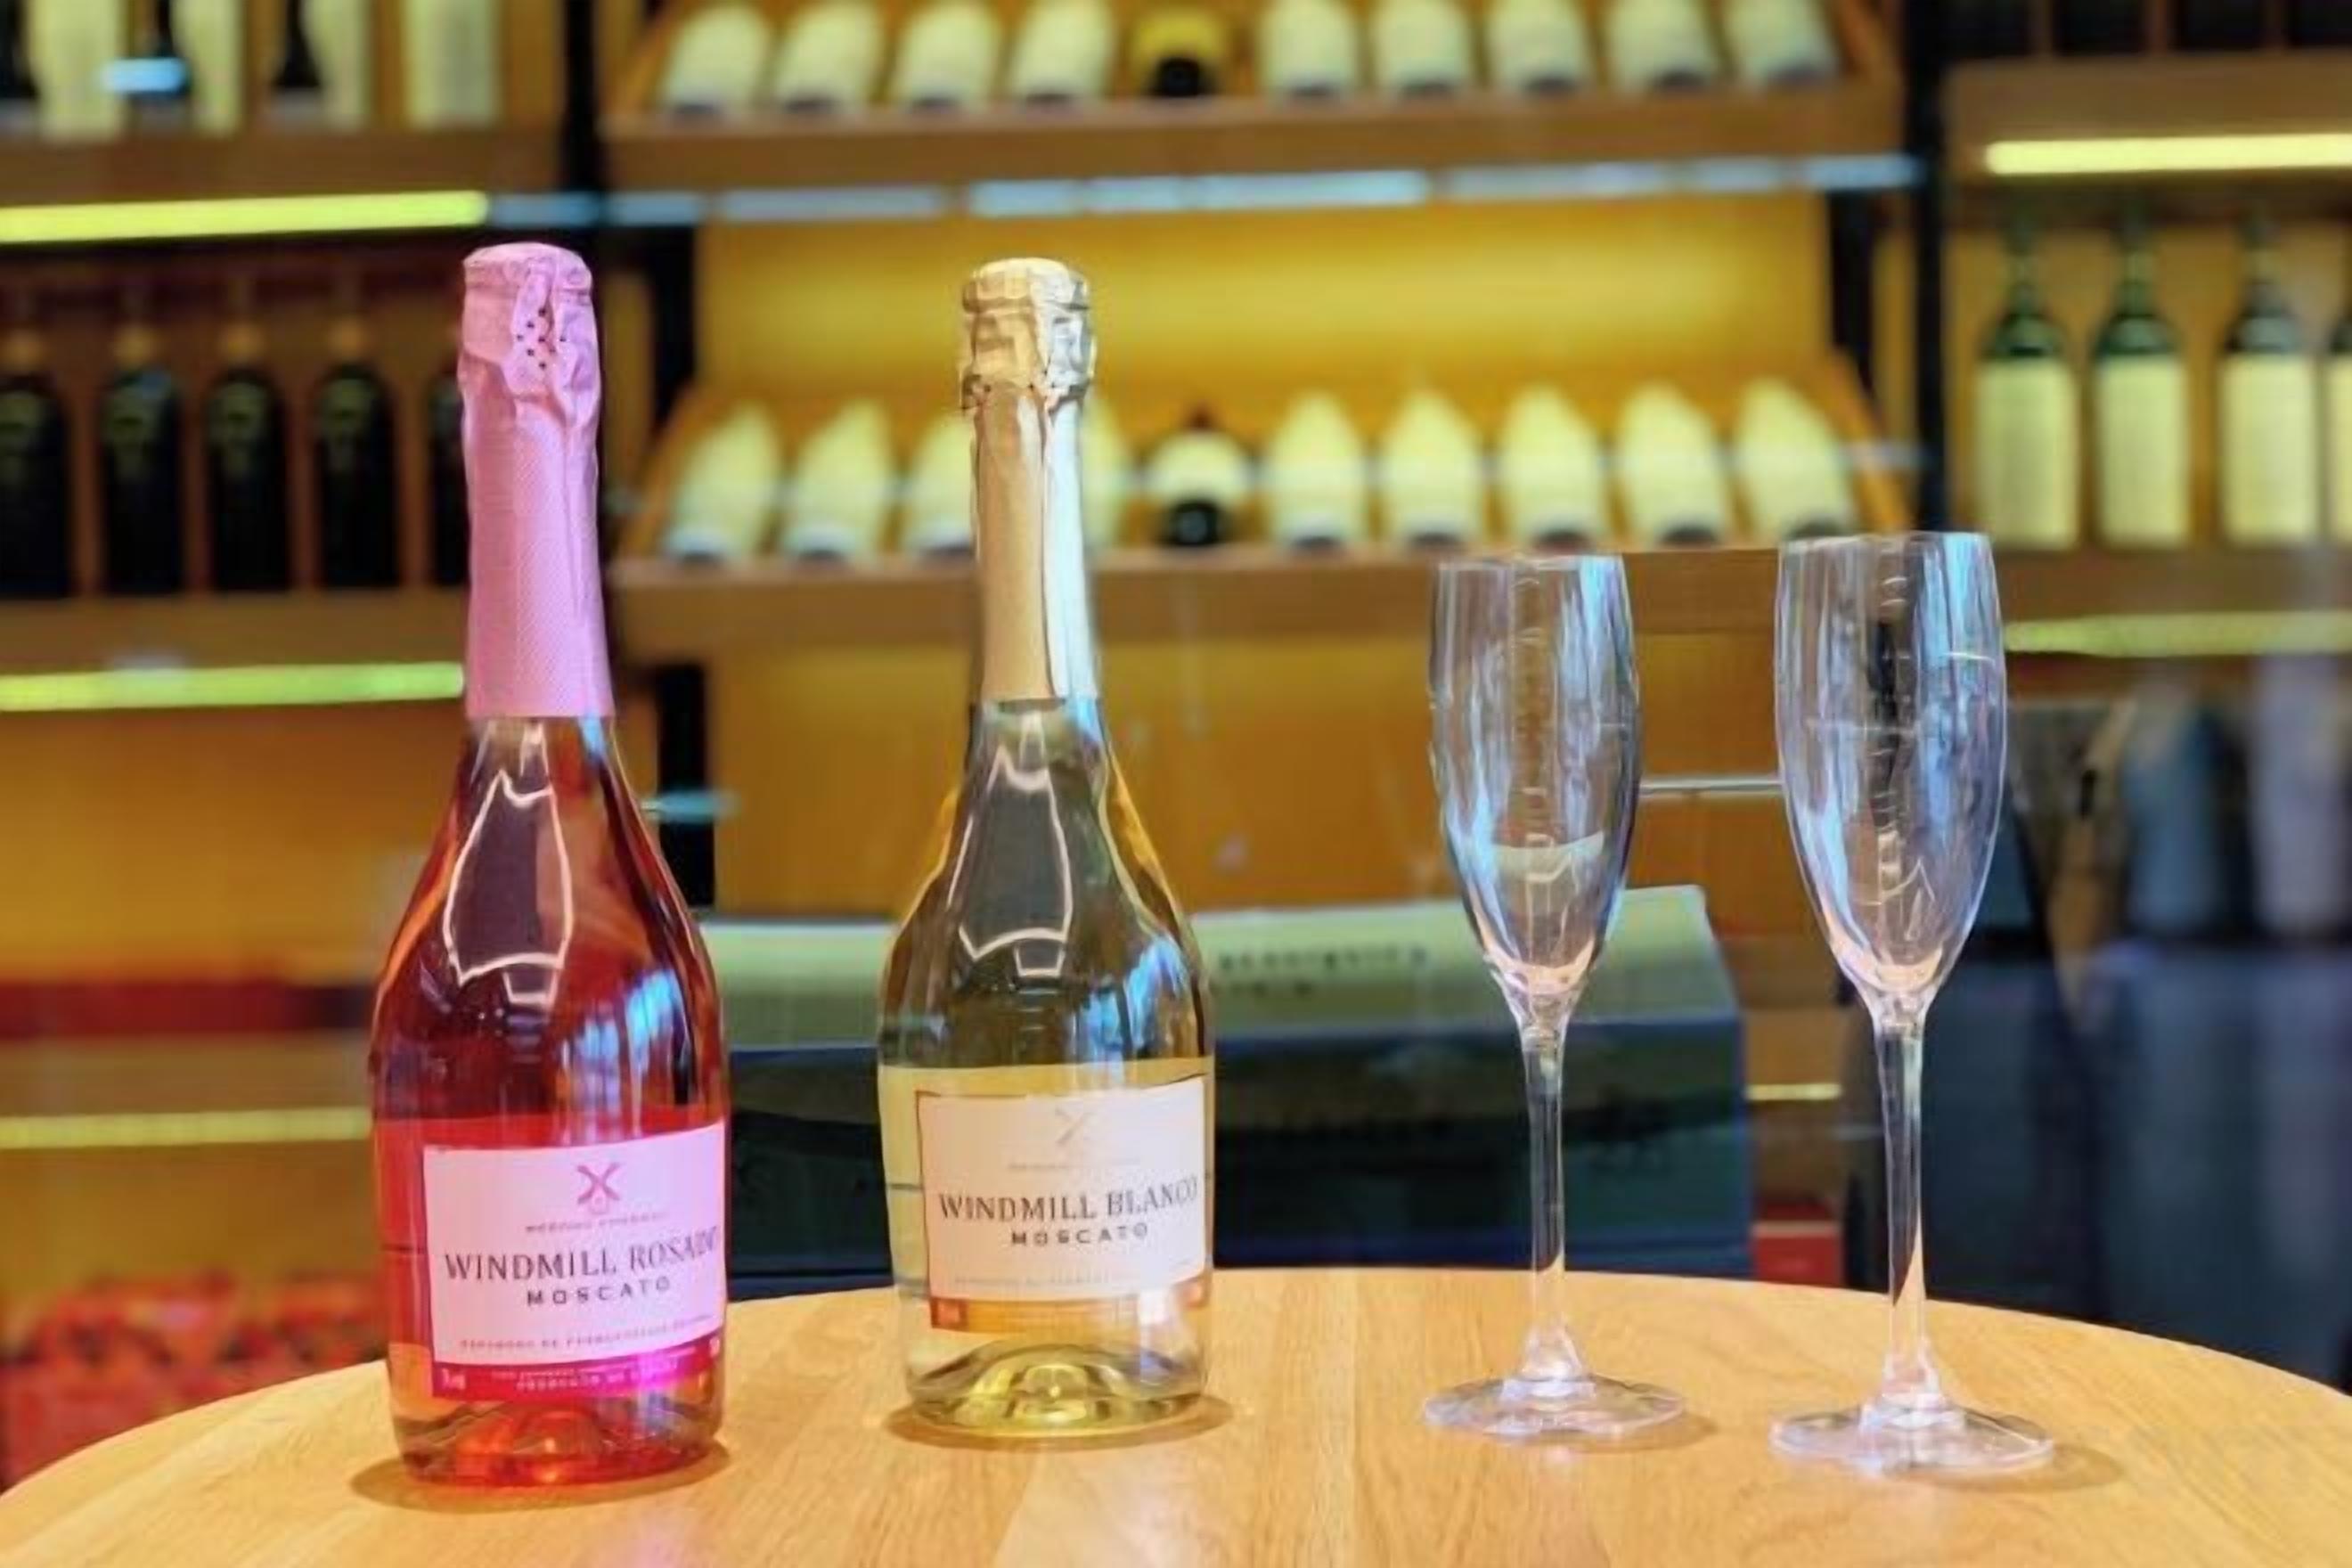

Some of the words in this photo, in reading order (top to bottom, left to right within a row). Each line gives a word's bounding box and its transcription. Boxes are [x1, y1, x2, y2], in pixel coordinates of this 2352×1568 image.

[940, 1193, 1097, 1221] WINDMILL
[1010, 1221, 1148, 1246] MOSCATO
[445, 1249, 617, 1282] WINDMILL
[527, 1276, 670, 1304] MOSCATO
